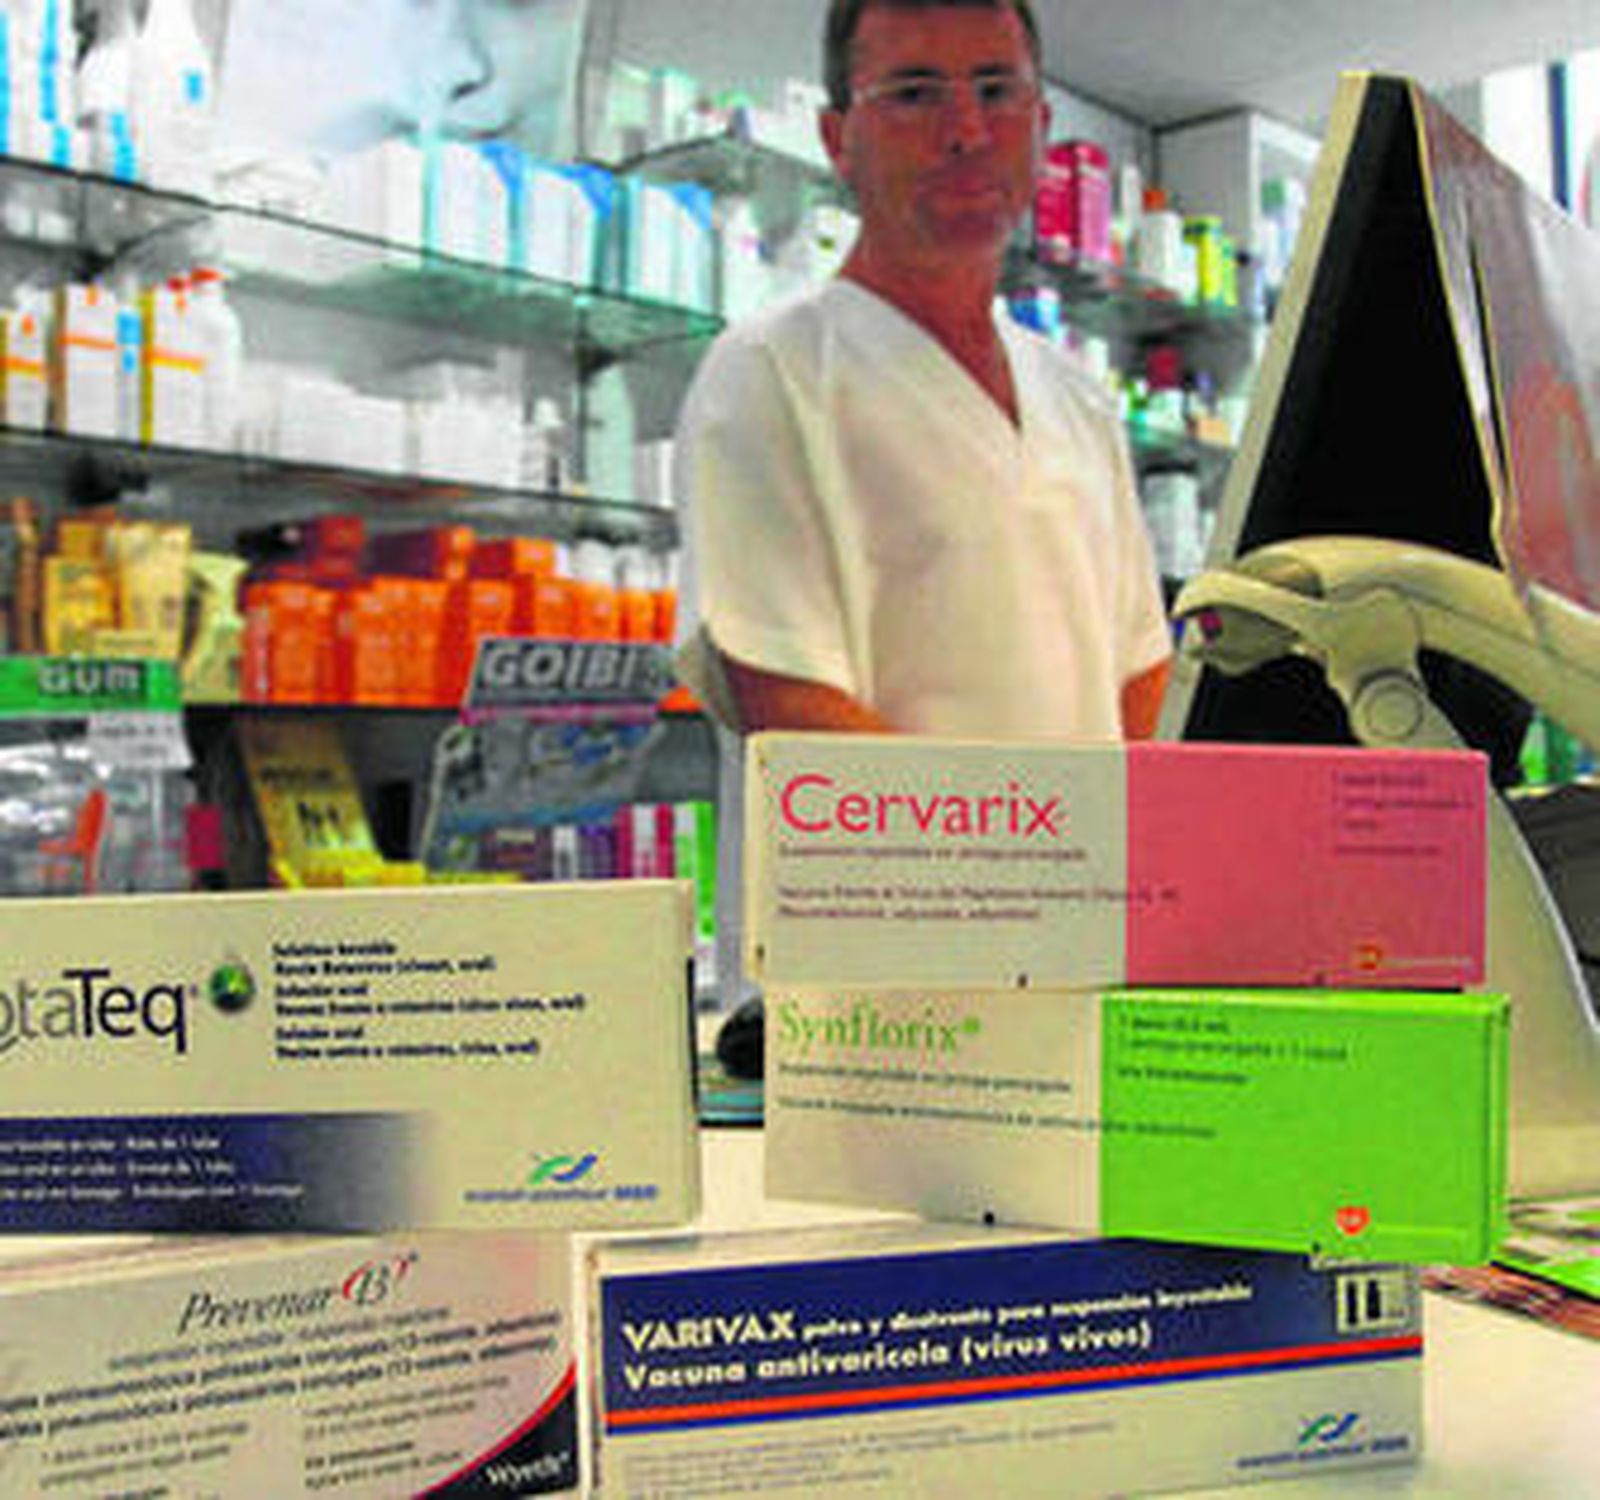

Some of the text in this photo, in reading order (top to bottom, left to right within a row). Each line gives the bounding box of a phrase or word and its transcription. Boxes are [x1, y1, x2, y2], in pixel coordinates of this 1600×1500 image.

[484, 640, 637, 688] GOIBI
[781, 774, 1061, 836] Cervarix
[176, 1288, 331, 1338] Prevenar
[622, 1310, 795, 1353] VARIVAX
[623, 1364, 746, 1391] Vacuna
[961, 1333, 1048, 1376] (virus
[1059, 1318, 1152, 1360] vivos)
